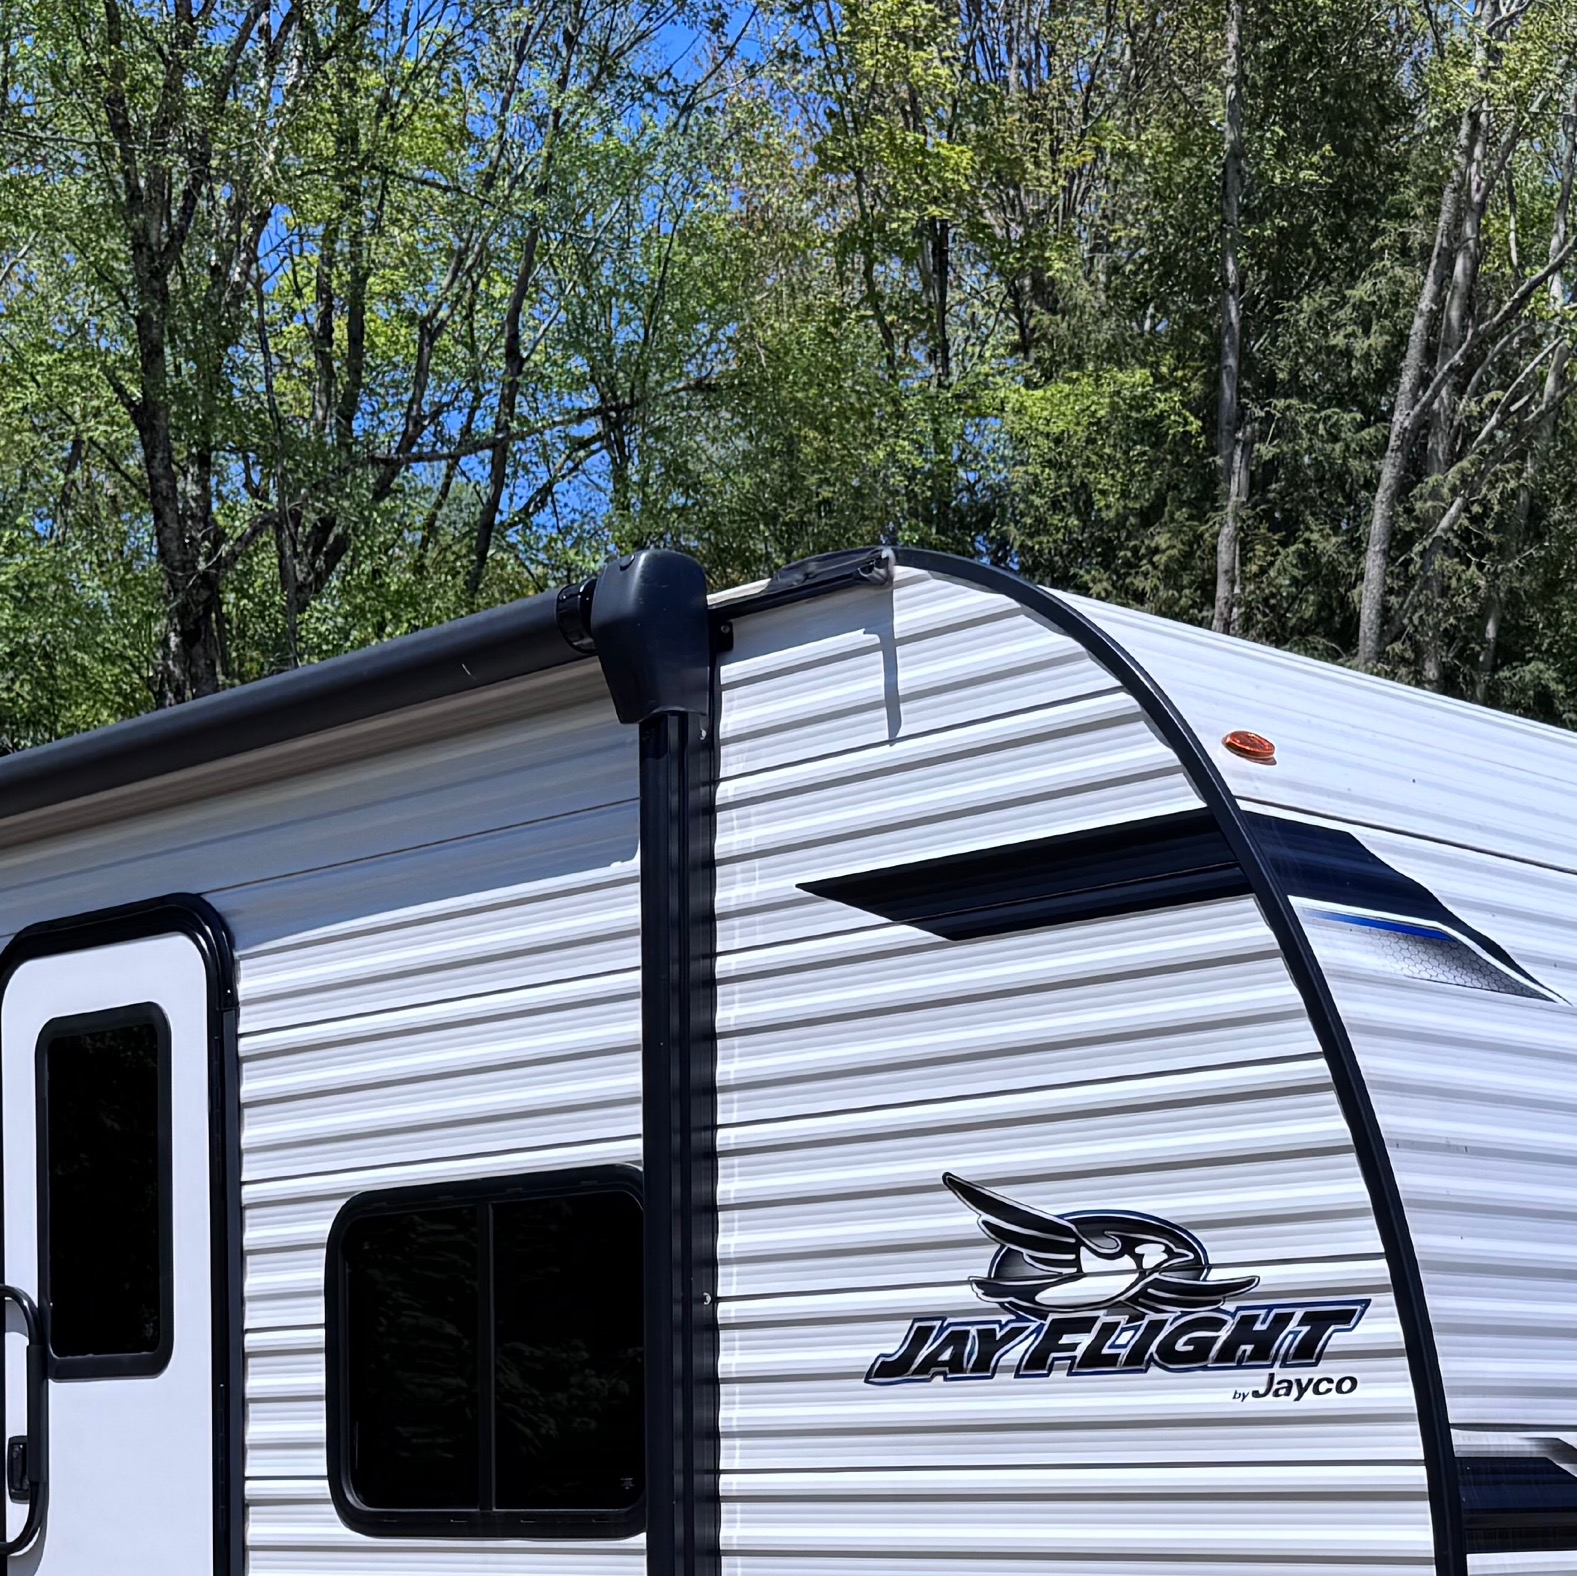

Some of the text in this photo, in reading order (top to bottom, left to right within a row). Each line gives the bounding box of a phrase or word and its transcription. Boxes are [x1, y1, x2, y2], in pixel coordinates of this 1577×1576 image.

[865, 1299, 1372, 1384] JAY FLIGHT
[1231, 1372, 1359, 1402] by Jayco
